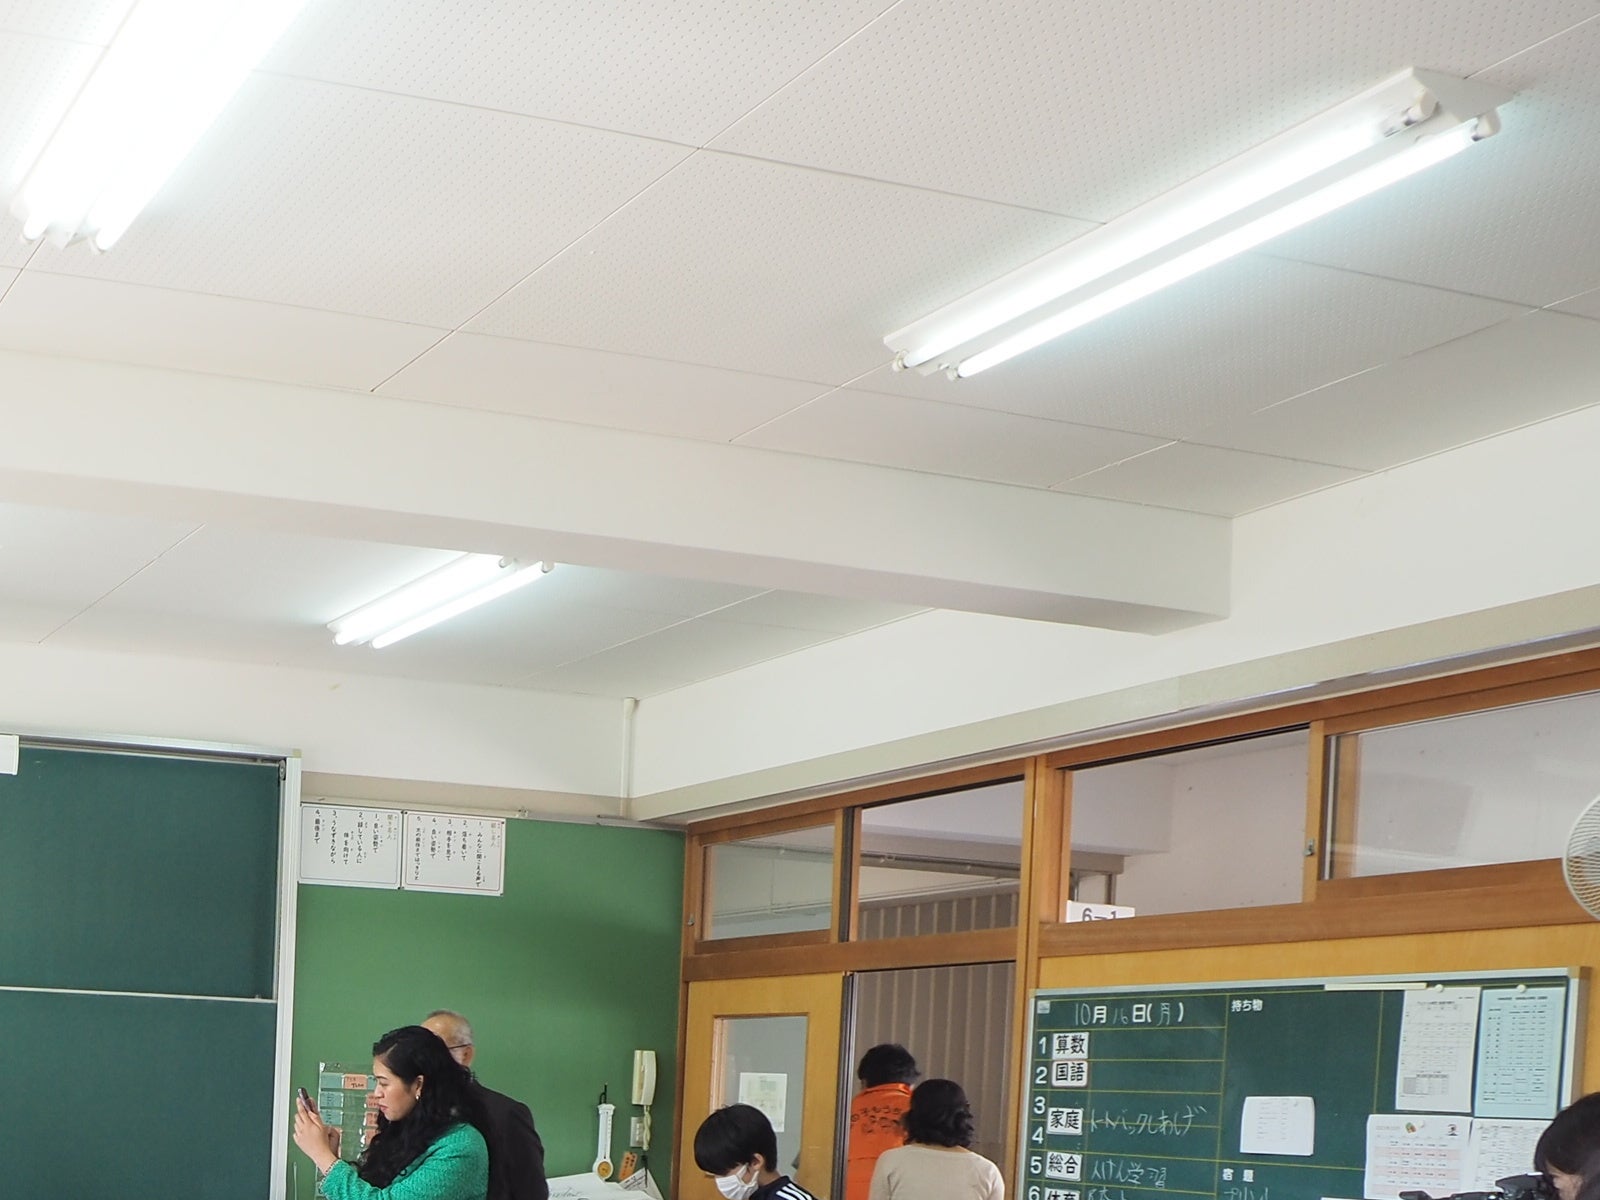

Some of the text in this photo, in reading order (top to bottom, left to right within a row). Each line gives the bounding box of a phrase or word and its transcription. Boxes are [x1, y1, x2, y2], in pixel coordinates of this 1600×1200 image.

[1231, 999, 1264, 1012] 持ち物
[1038, 1036, 1047, 1054] 1
[1055, 1034, 1085, 1054] 算数
[1035, 1066, 1048, 1084] 2
[1055, 1062, 1085, 1082] 国語
[1034, 1096, 1046, 1115] 3
[1049, 1109, 1080, 1130] 家庭
[1031, 1128, 1044, 1144] 4
[1030, 1156, 1042, 1175] 5
[1048, 1154, 1079, 1174] 総合
